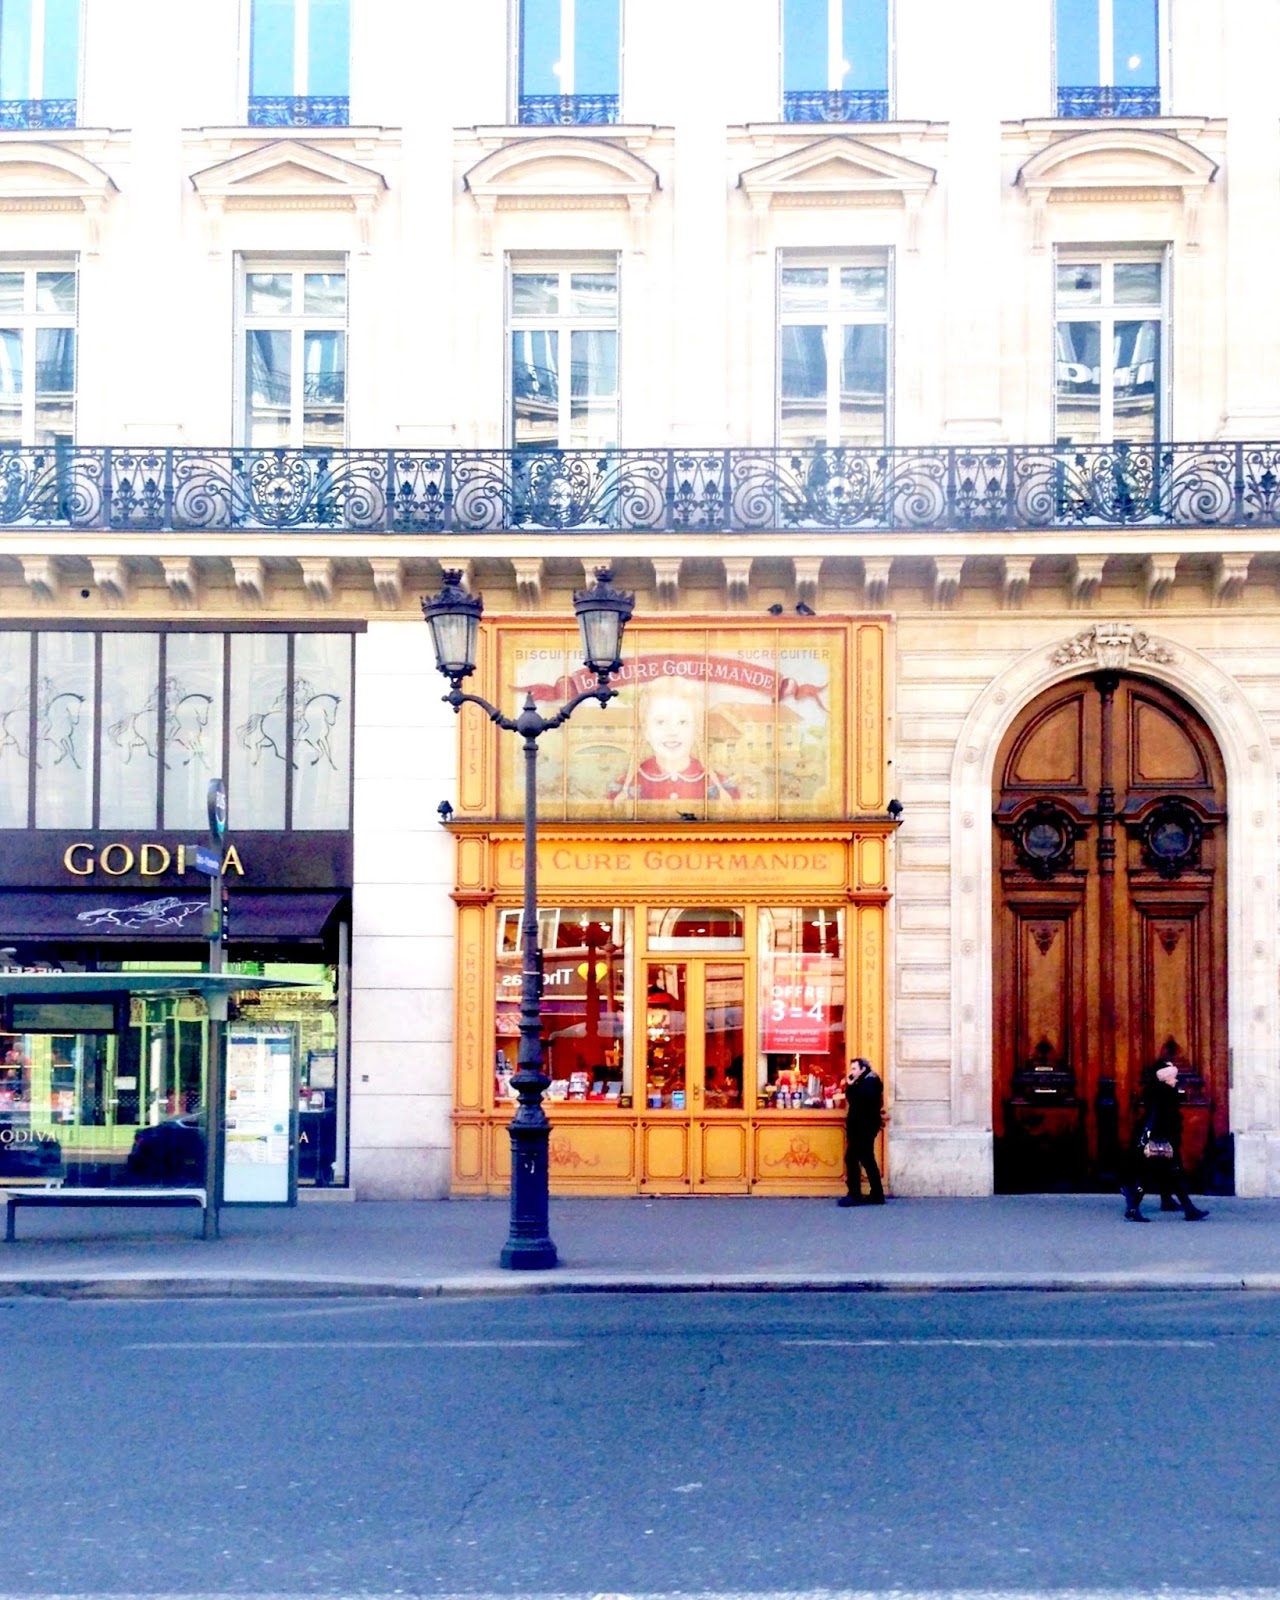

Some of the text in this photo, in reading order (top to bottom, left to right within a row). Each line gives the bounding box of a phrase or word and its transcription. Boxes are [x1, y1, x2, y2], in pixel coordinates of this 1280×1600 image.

[515, 649, 586, 660] BISCUITIE
[608, 662, 660, 682] CURE
[662, 659, 774, 689] GOURMANDE
[64, 844, 244, 876] GODIA
[552, 850, 631, 870] CURE
[643, 850, 828, 870] GOURMANDE
[772, 985, 825, 998] OFFRE
[771, 999, 785, 1021] 3
[806, 1001, 824, 1022] 4
